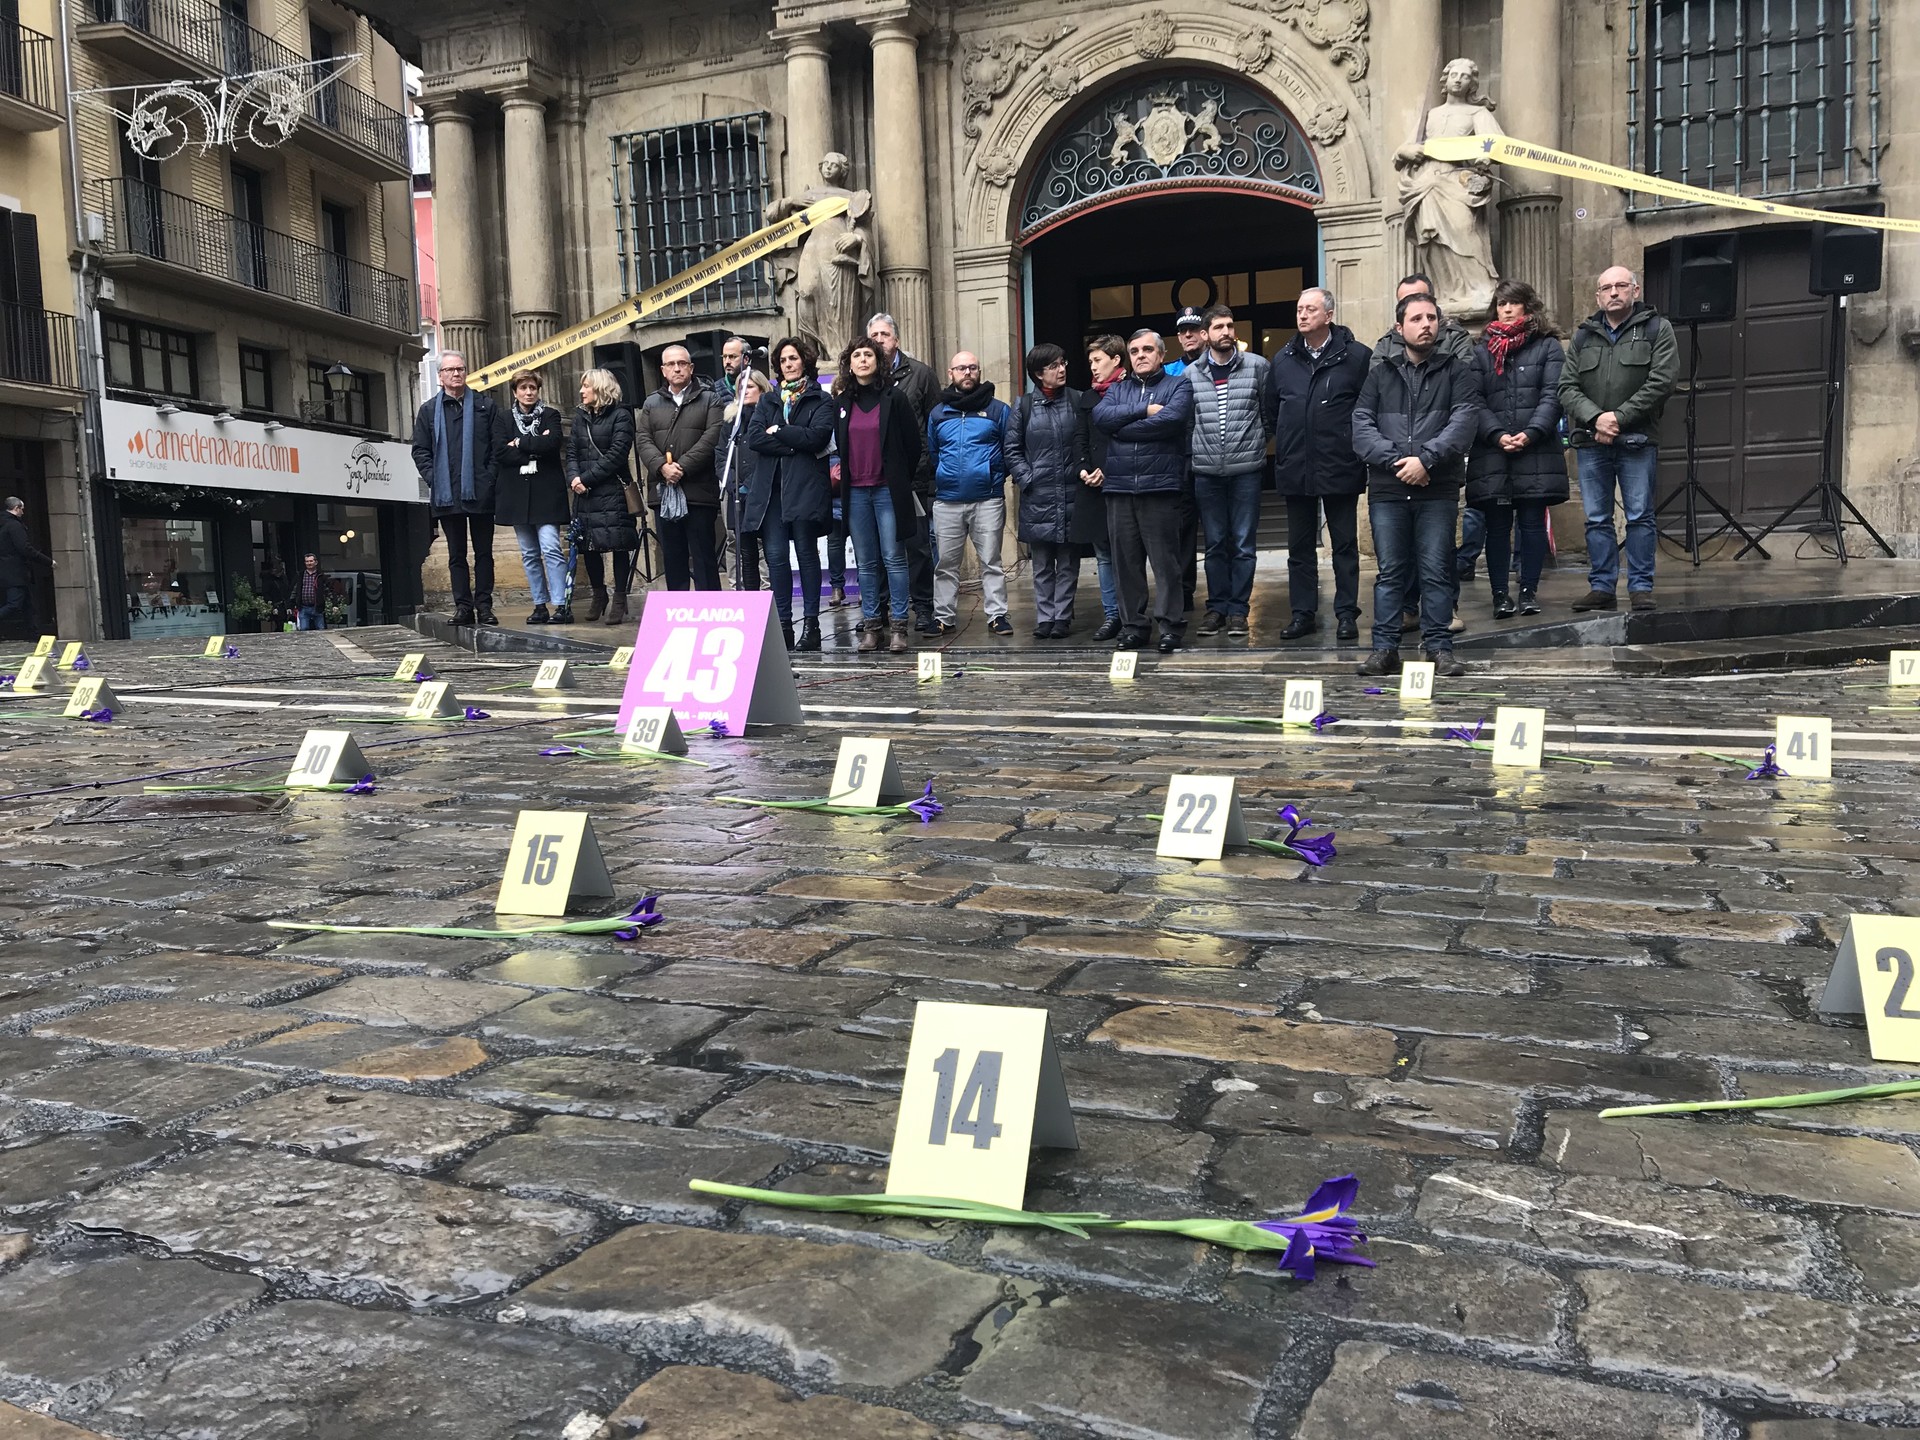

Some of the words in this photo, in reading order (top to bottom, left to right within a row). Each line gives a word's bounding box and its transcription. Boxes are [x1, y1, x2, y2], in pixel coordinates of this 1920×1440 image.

[986, 196, 998, 233] PATET
[1010, 97, 1050, 148] OMNIBUS
[1192, 35, 1218, 47] COR
[1276, 69, 1310, 101] VALDE
[1331, 151, 1348, 194] MAGIS
[1504, 144, 1526, 157] STOP
[1527, 148, 1577, 168] INDARKERIA
[650, 292, 664, 305] STOP
[664, 277, 695, 297] INDARKERIA
[725, 253, 740, 266] STOP
[740, 238, 768, 258] VIOLENCIA
[766, 222, 797, 245] MACHISTA
[494, 366, 509, 378] STOP
[508, 354, 537, 372] INDARKERIA
[565, 334, 578, 346] STOP
[578, 323, 602, 339] VIOLENCIA
[602, 310, 628, 328] MACHISTA
[145, 428, 291, 473] carnedenavarra.com
[129, 459, 145, 468] SHOP
[666, 608, 745, 622] YOLANDA
[211, 642, 217, 652] 3
[614, 652, 629, 663] 28
[25, 664, 35, 679] 9
[400, 660, 416, 674] 25
[540, 666, 558, 680] 20
[642, 626, 745, 703] 43
[923, 658, 936, 672] 21
[1115, 658, 1131, 672] 33
[1899, 658, 1915, 675] 17
[1410, 672, 1426, 689] 13
[74, 687, 94, 707] 38
[417, 691, 437, 709] 31
[1289, 690, 1314, 711] 40
[631, 718, 660, 743] 39
[1510, 722, 1527, 750] 4
[1786, 731, 1819, 761] 41
[302, 745, 331, 774] 10
[847, 754, 868, 789] 6
[1172, 792, 1218, 835] 22
[522, 834, 564, 885] 15
[928, 1047, 1004, 1150] 14
